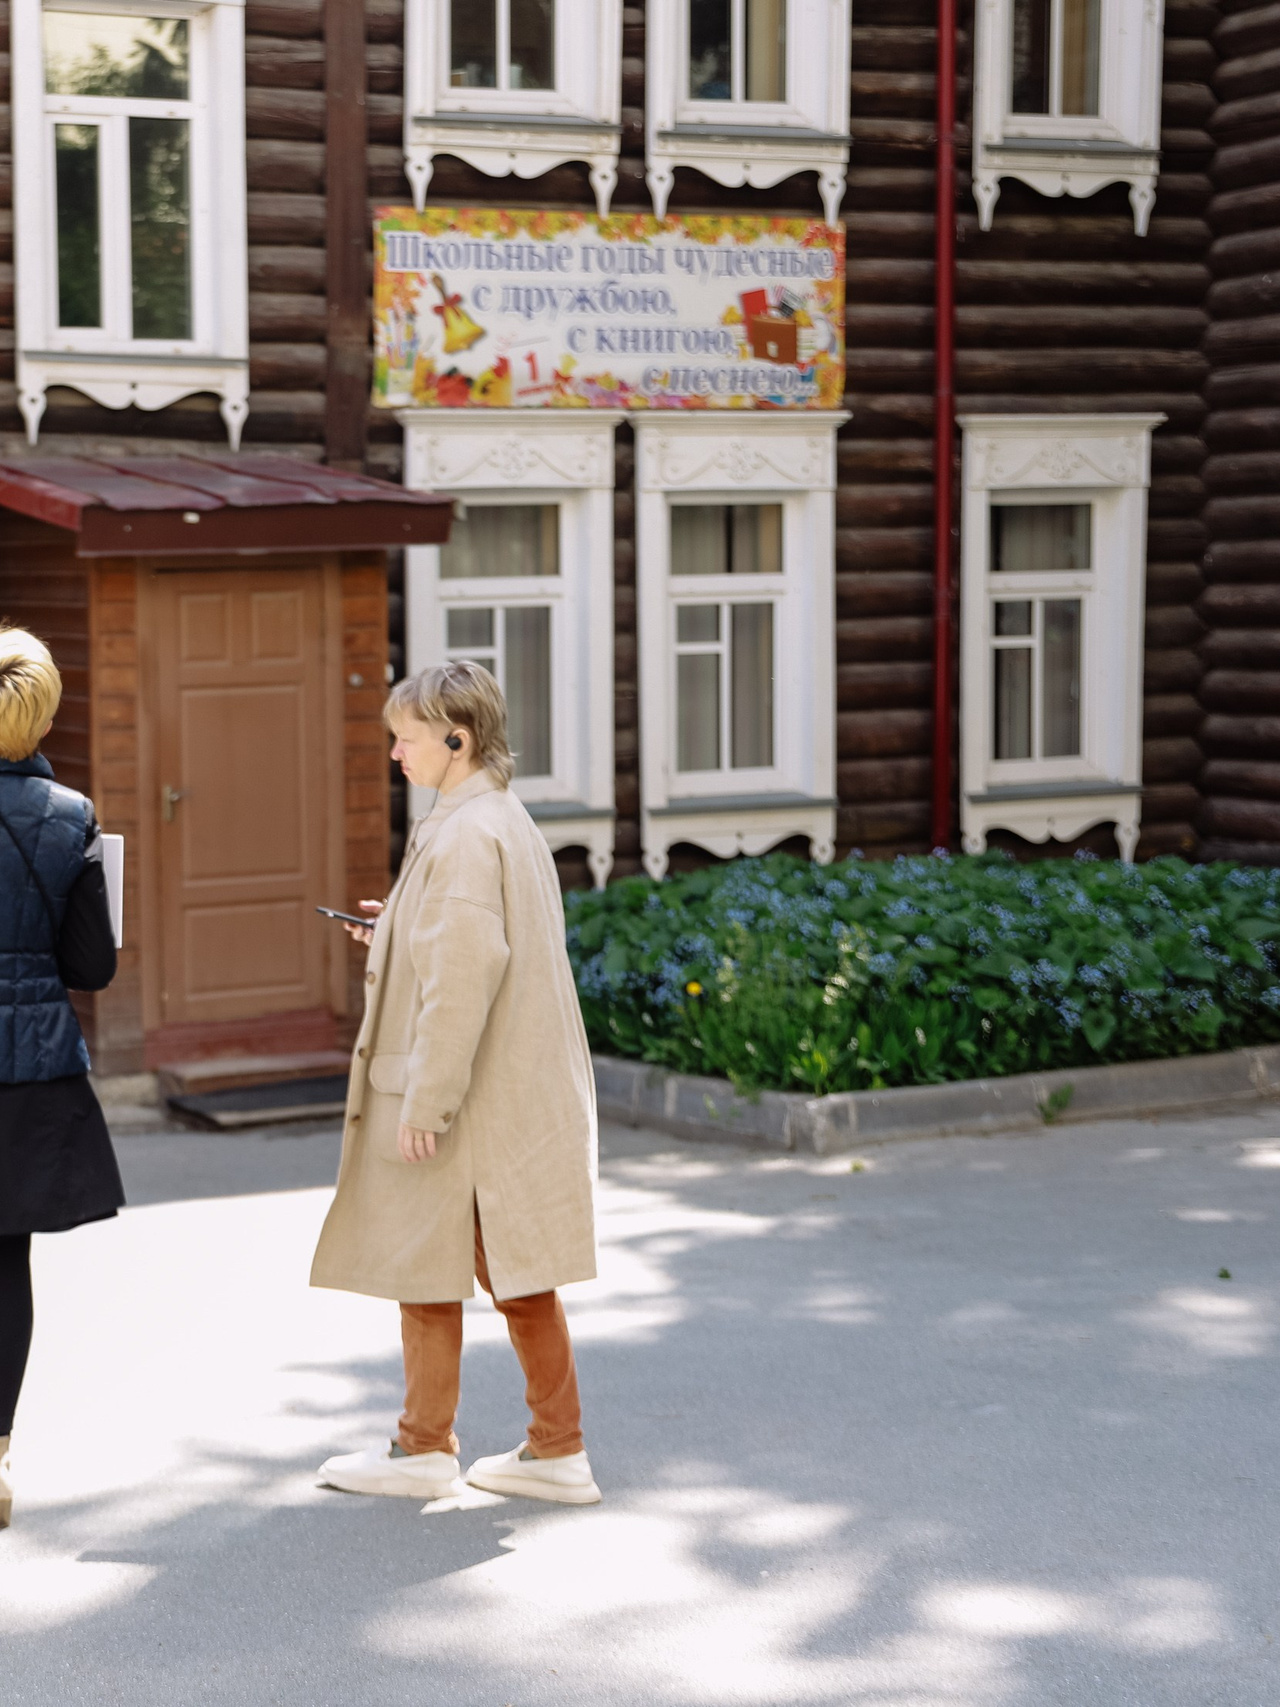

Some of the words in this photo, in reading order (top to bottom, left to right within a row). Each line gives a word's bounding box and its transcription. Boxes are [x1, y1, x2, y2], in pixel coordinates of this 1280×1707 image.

[387, 234, 573, 273] Школьные
[579, 245, 668, 275] годы
[673, 246, 835, 284] чудесные
[471, 284, 492, 313] с
[498, 279, 677, 321] дружбою,
[567, 327, 587, 353] с
[524, 353, 540, 382] 1
